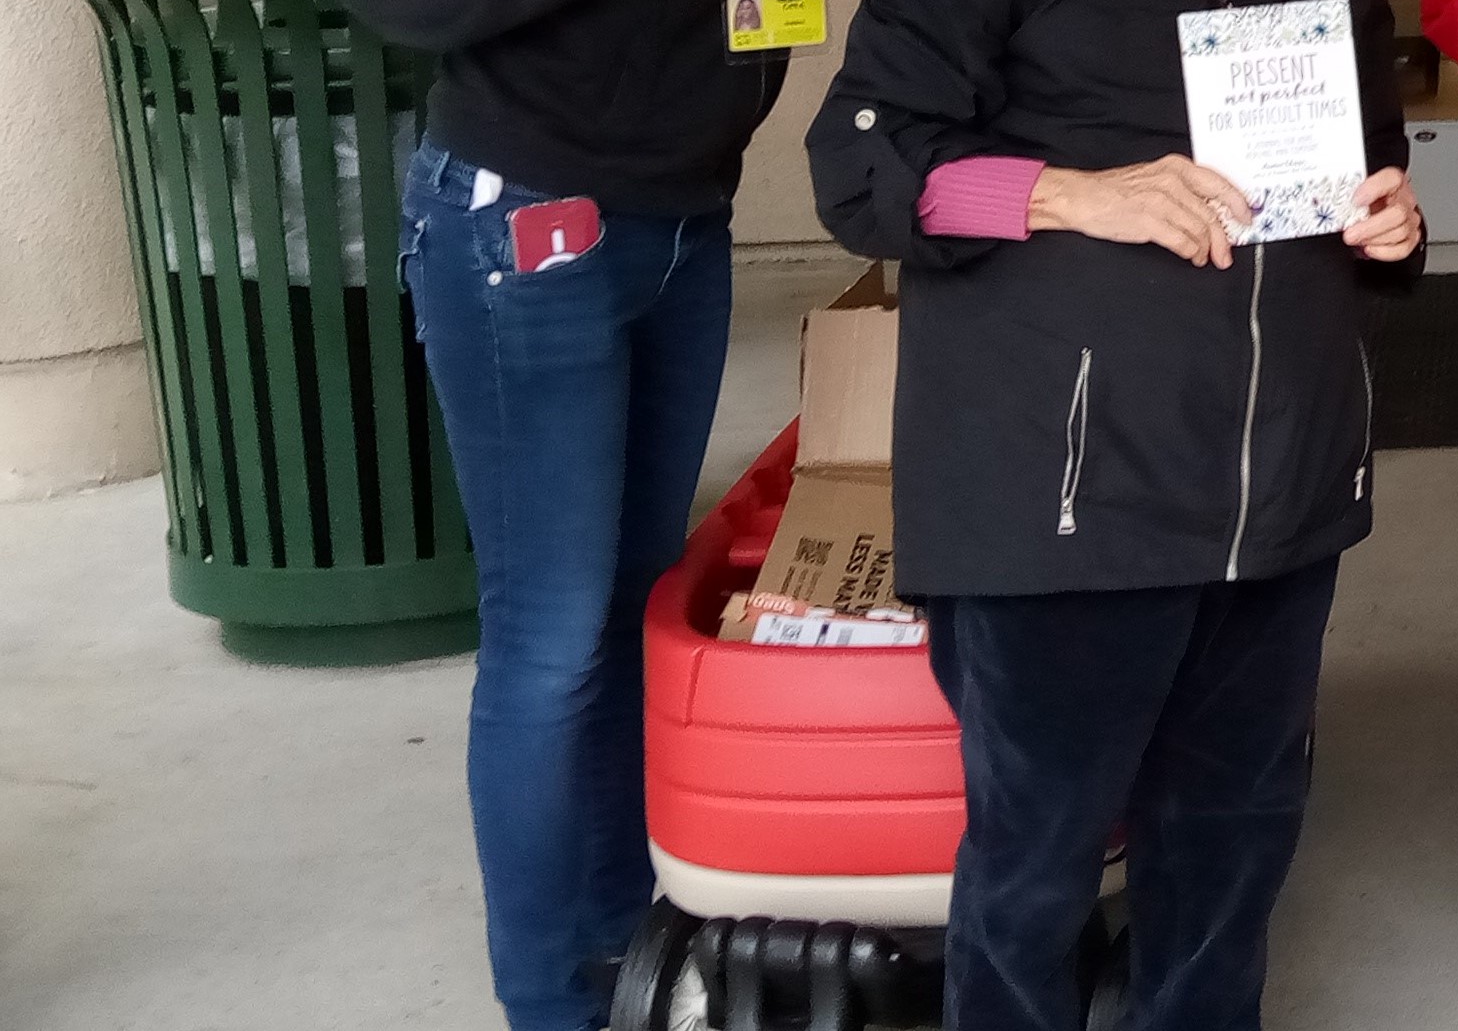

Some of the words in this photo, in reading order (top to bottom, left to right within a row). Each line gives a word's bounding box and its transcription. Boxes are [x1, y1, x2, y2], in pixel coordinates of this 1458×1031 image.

[1230, 52, 1317, 88] PRESENT
[1209, 113, 1233, 131] FOR
[1239, 104, 1301, 128] DIFFICULT
[1307, 97, 1347, 119] TIMES
[846, 533, 876, 574] LESS
